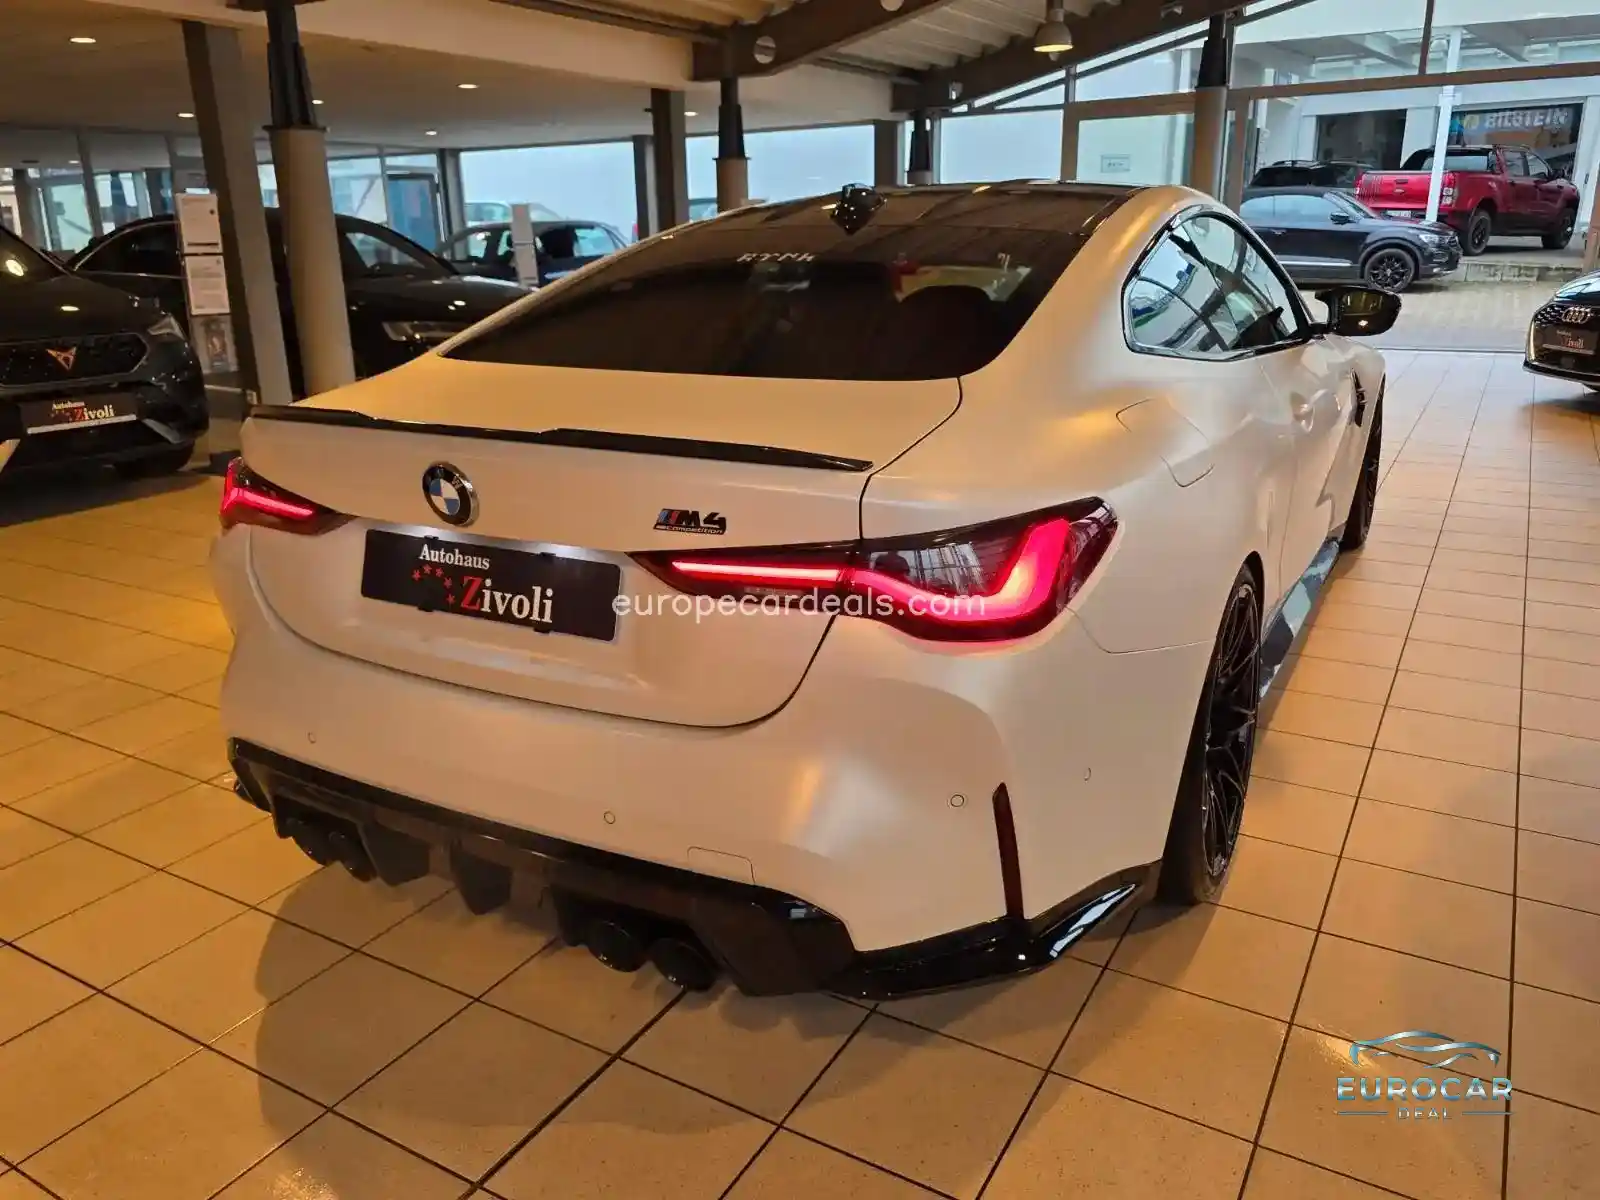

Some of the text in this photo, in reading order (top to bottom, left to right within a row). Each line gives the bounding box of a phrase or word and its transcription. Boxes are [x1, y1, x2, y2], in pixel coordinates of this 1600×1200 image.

[74, 404, 115, 421] Zivoli
[674, 508, 727, 529] M4
[419, 543, 491, 570] Autohaus
[460, 575, 553, 623] Zivoli
